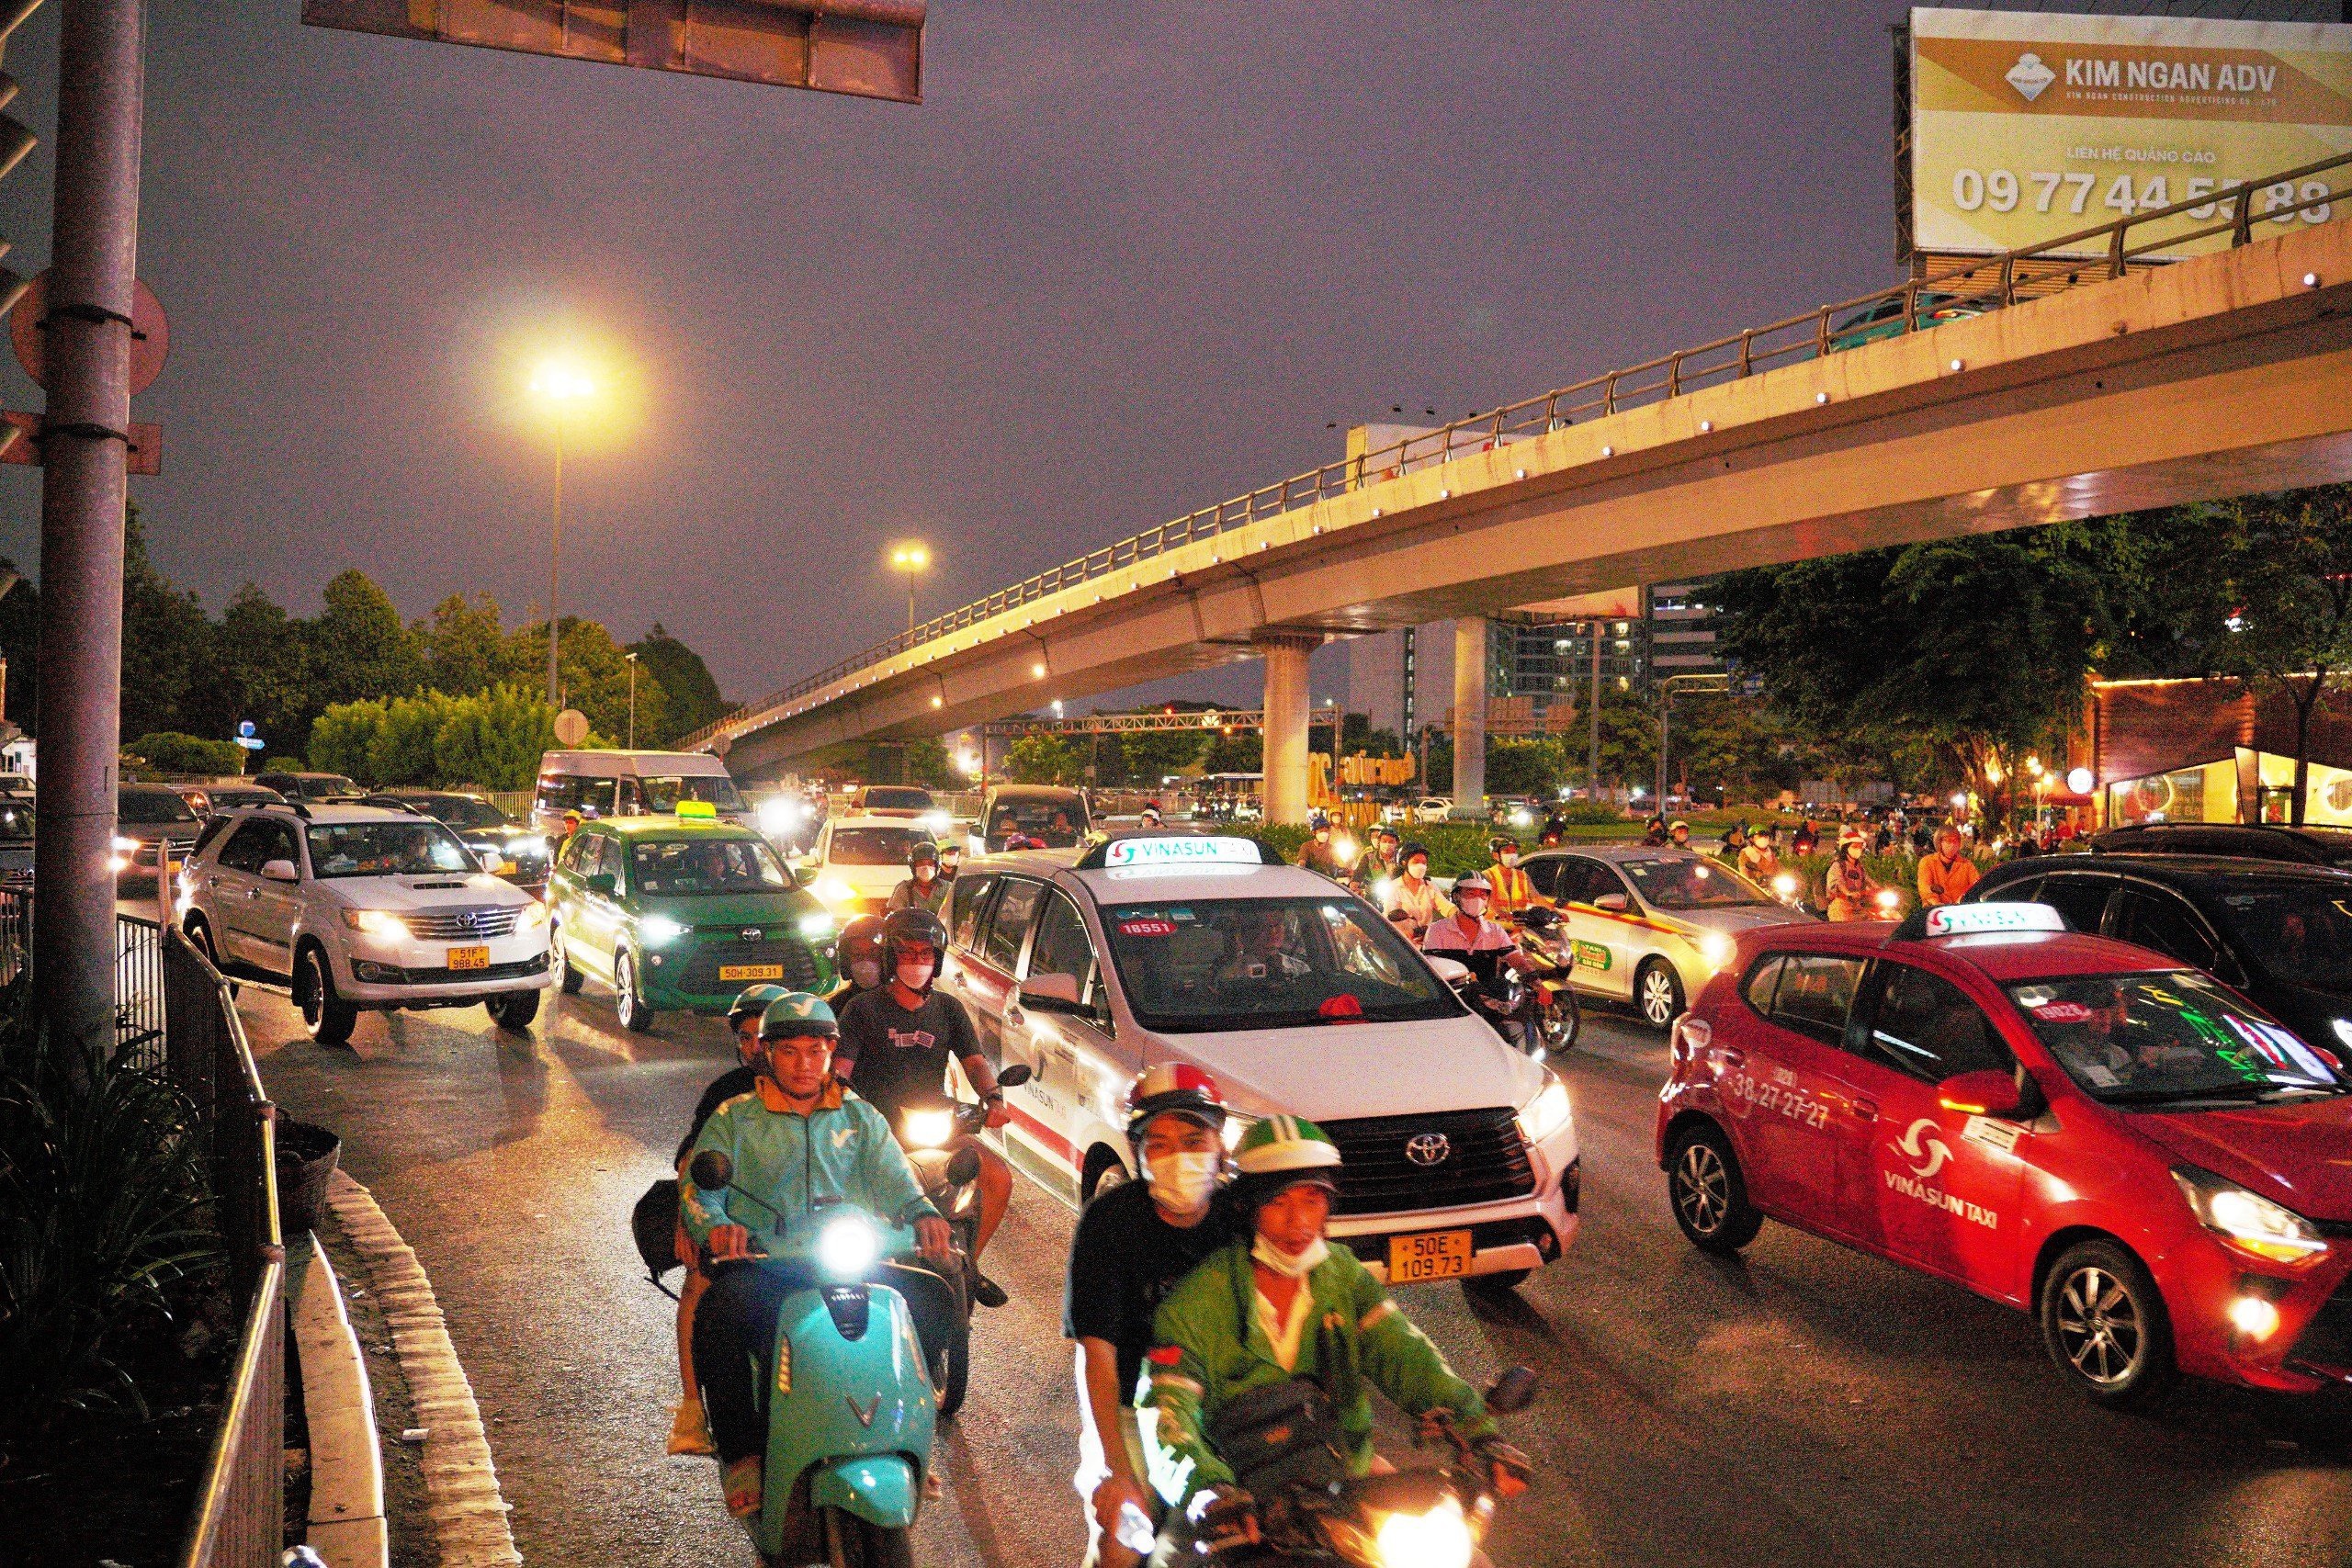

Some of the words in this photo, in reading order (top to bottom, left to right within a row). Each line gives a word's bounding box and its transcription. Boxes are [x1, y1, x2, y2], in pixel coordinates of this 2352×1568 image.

[2066, 58, 2120, 87] KIM
[2127, 61, 2210, 91] NGAN
[2216, 63, 2277, 93] ADV
[1952, 168, 2018, 212] 09
[2030, 172, 2096, 214] 77
[2104, 175, 2170, 216] 44
[2265, 182, 2331, 225] 88
[1142, 840, 1217, 857] VINASUN
[1122, 922, 1170, 934] 18551
[460, 948, 477, 958] 51F
[1884, 1169, 1964, 1217] VINASUN
[1965, 1201, 1997, 1230] TAXI
[1415, 1235, 1448, 1257] 50E
[1402, 1255, 1463, 1278] 109.73
